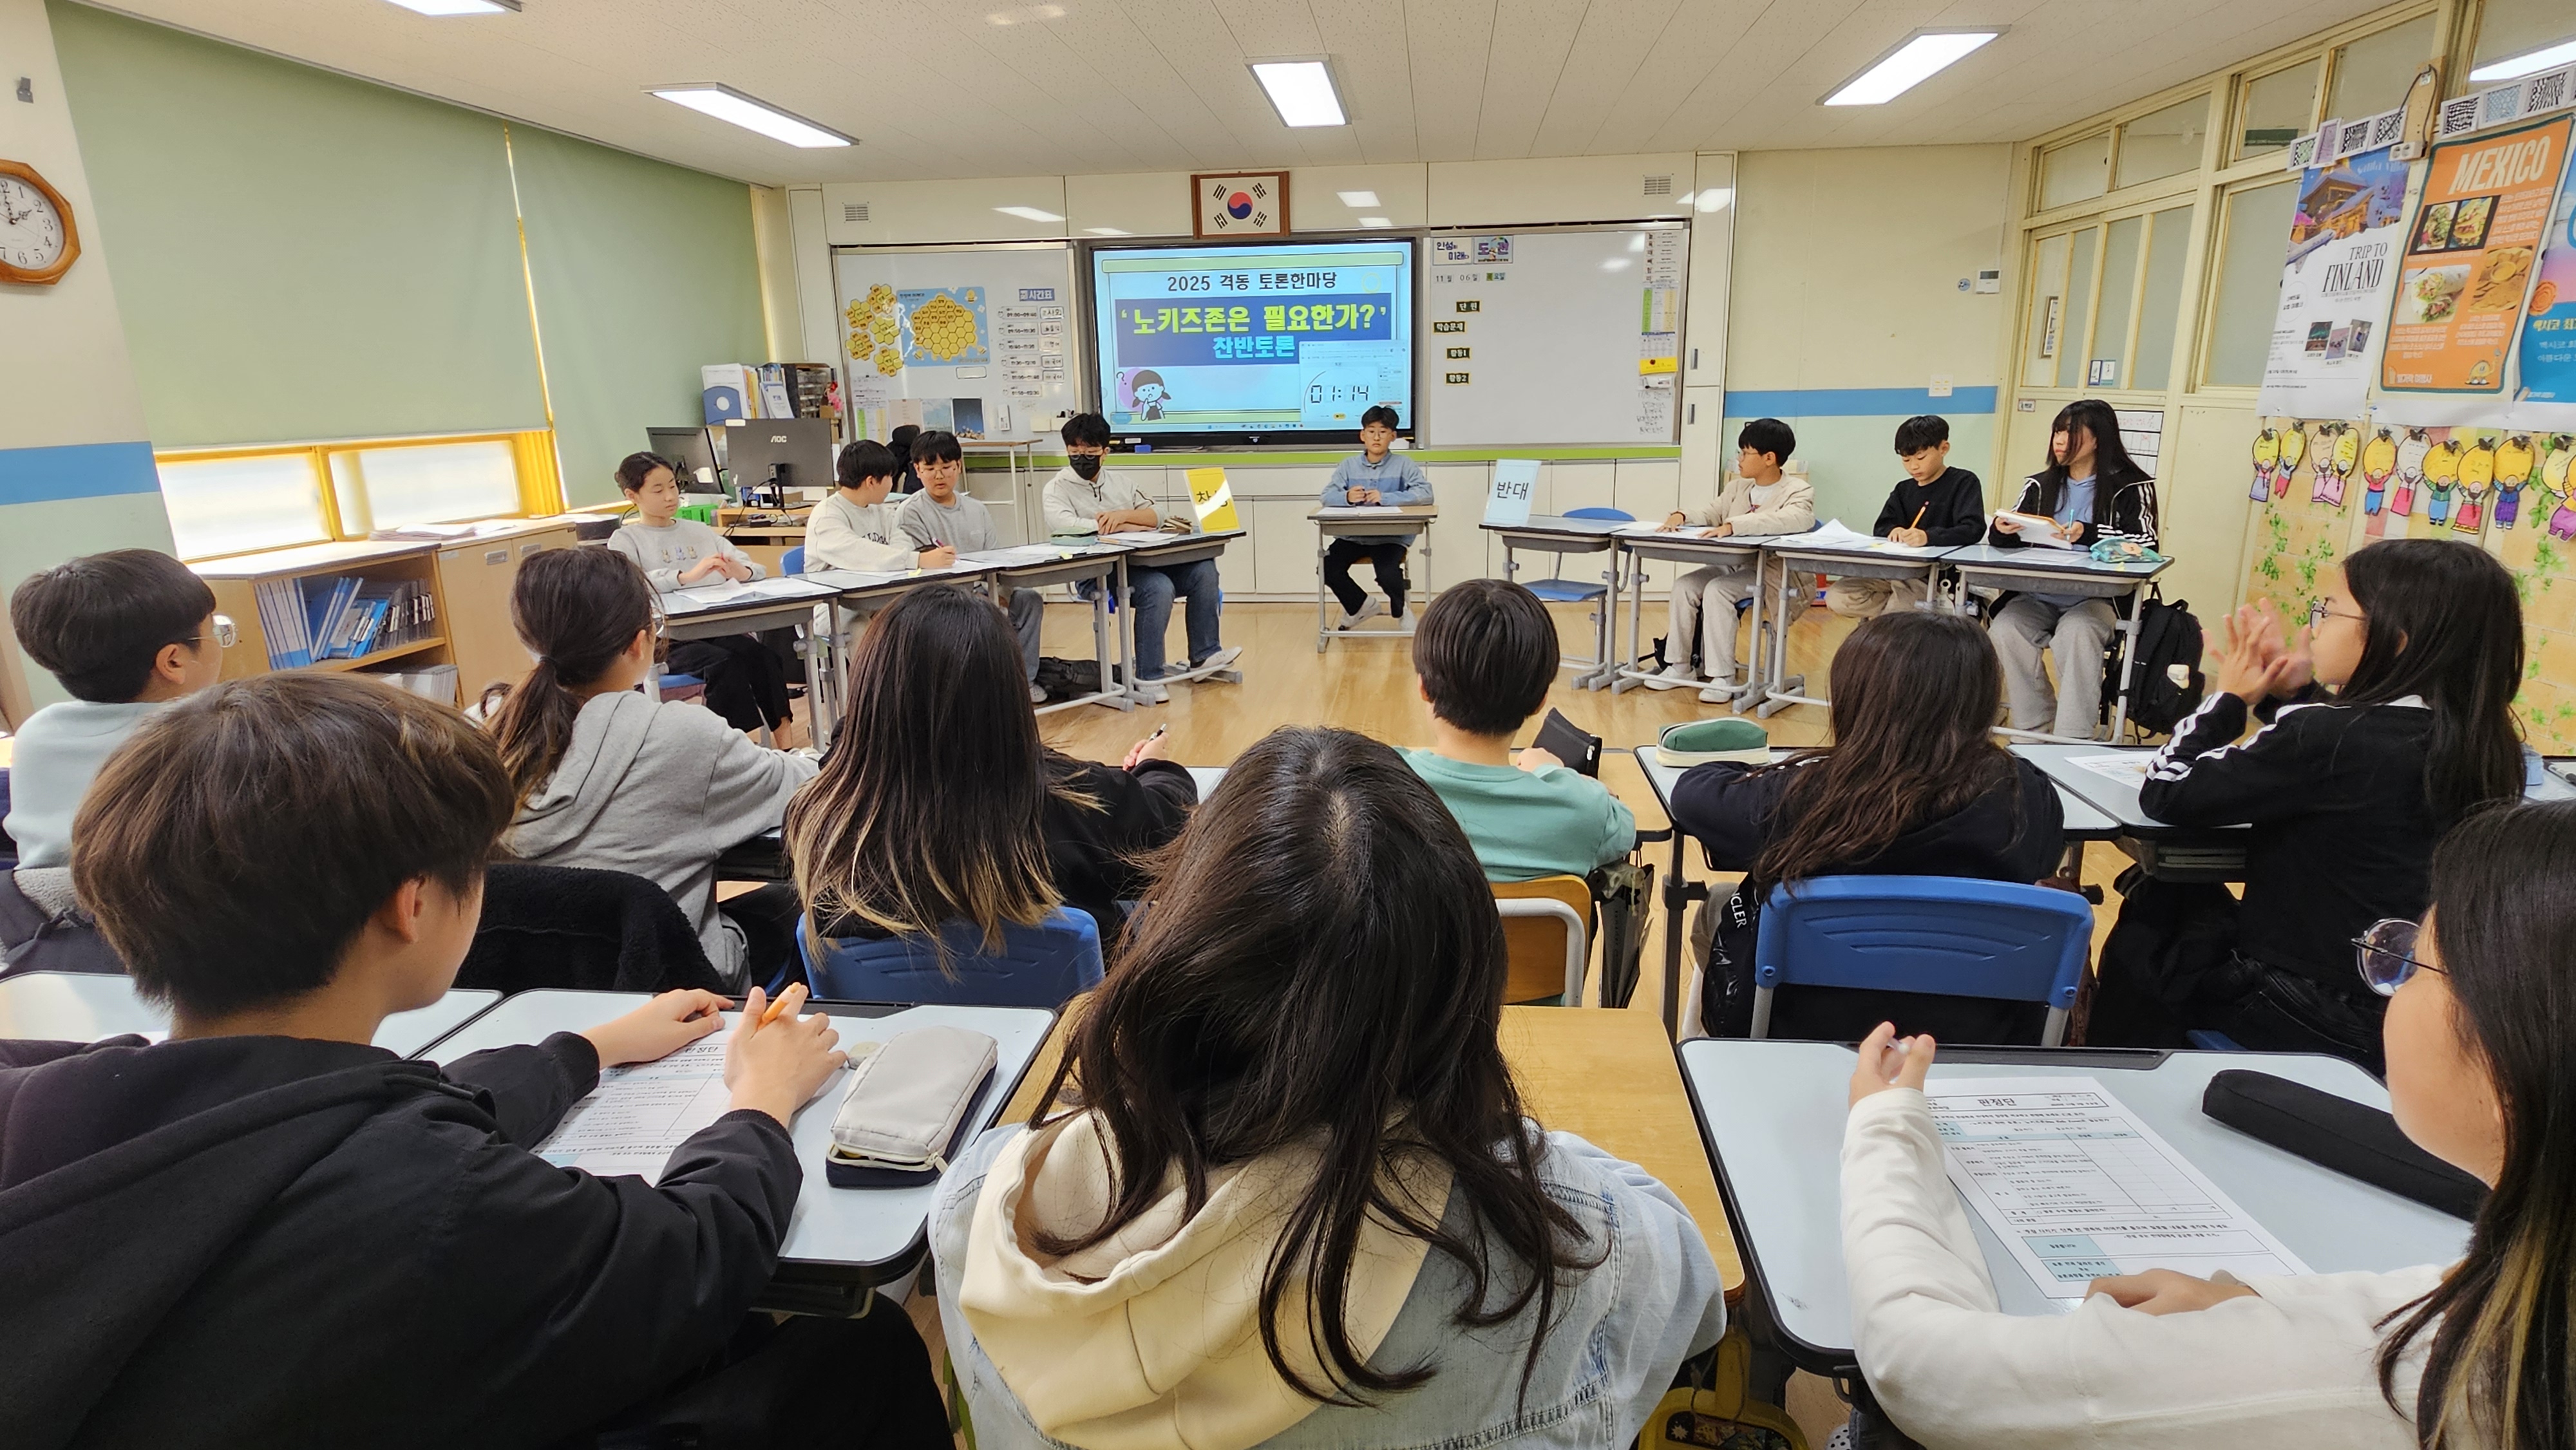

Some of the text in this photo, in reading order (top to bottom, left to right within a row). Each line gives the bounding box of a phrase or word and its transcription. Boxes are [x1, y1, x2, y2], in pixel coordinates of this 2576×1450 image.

[2448, 135, 2551, 194] MEXICO
[18, 186, 24, 198] 1
[33, 200, 44, 213] 2
[43, 218, 53, 231] 3
[44, 236, 52, 248] 4
[0, 247, 6, 259] 7
[17, 251, 27, 265] 6
[34, 249, 44, 261] 5
[2349, 243, 2387, 260] TRIP TO
[1168, 273, 1337, 291] 2025 격동 토론한마당
[2322, 259, 2383, 292] FINLAND
[1029, 290, 1052, 299] 시간표
[1213, 335, 1295, 359] 찬반토론
[1311, 385, 1369, 403] 01:14
[1497, 482, 1529, 500] 반대
[1978, 1098, 2017, 1106] 판정단
